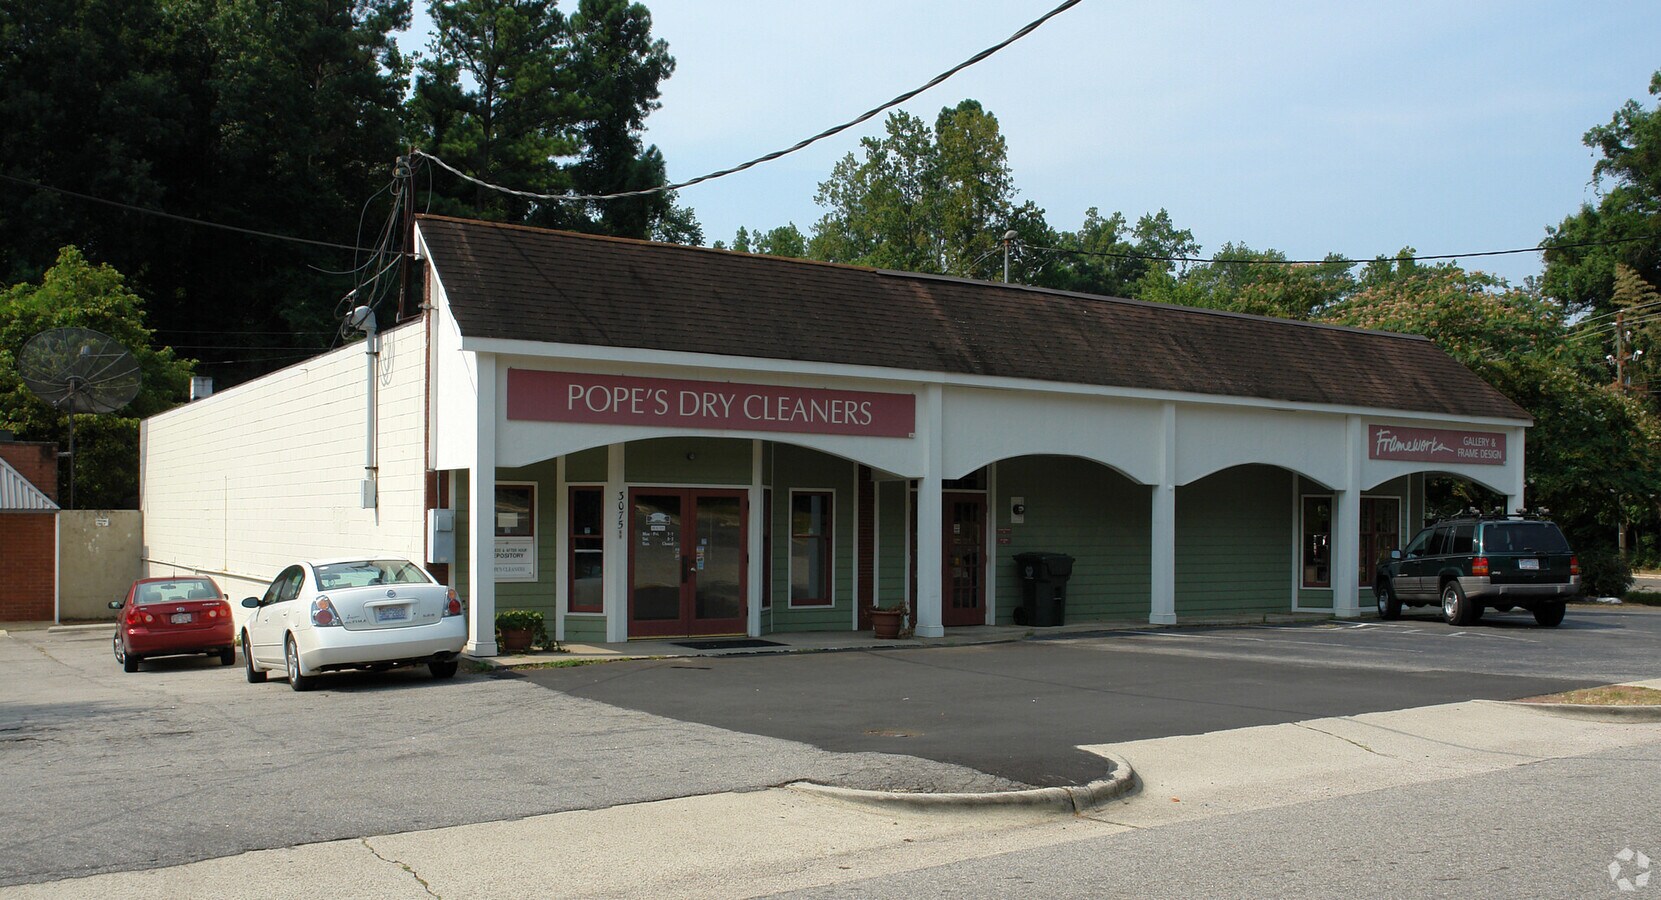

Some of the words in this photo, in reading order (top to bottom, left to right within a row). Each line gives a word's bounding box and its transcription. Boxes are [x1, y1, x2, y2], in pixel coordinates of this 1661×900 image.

[567, 383, 669, 417] POPE'S
[679, 390, 735, 419] DRY
[743, 394, 872, 425] CLEANERS
[1463, 436, 1489, 448] GALLERY
[1491, 438, 1497, 447] &
[1457, 448, 1479, 459] FRAME
[1480, 449, 1502, 459] DESIGN
